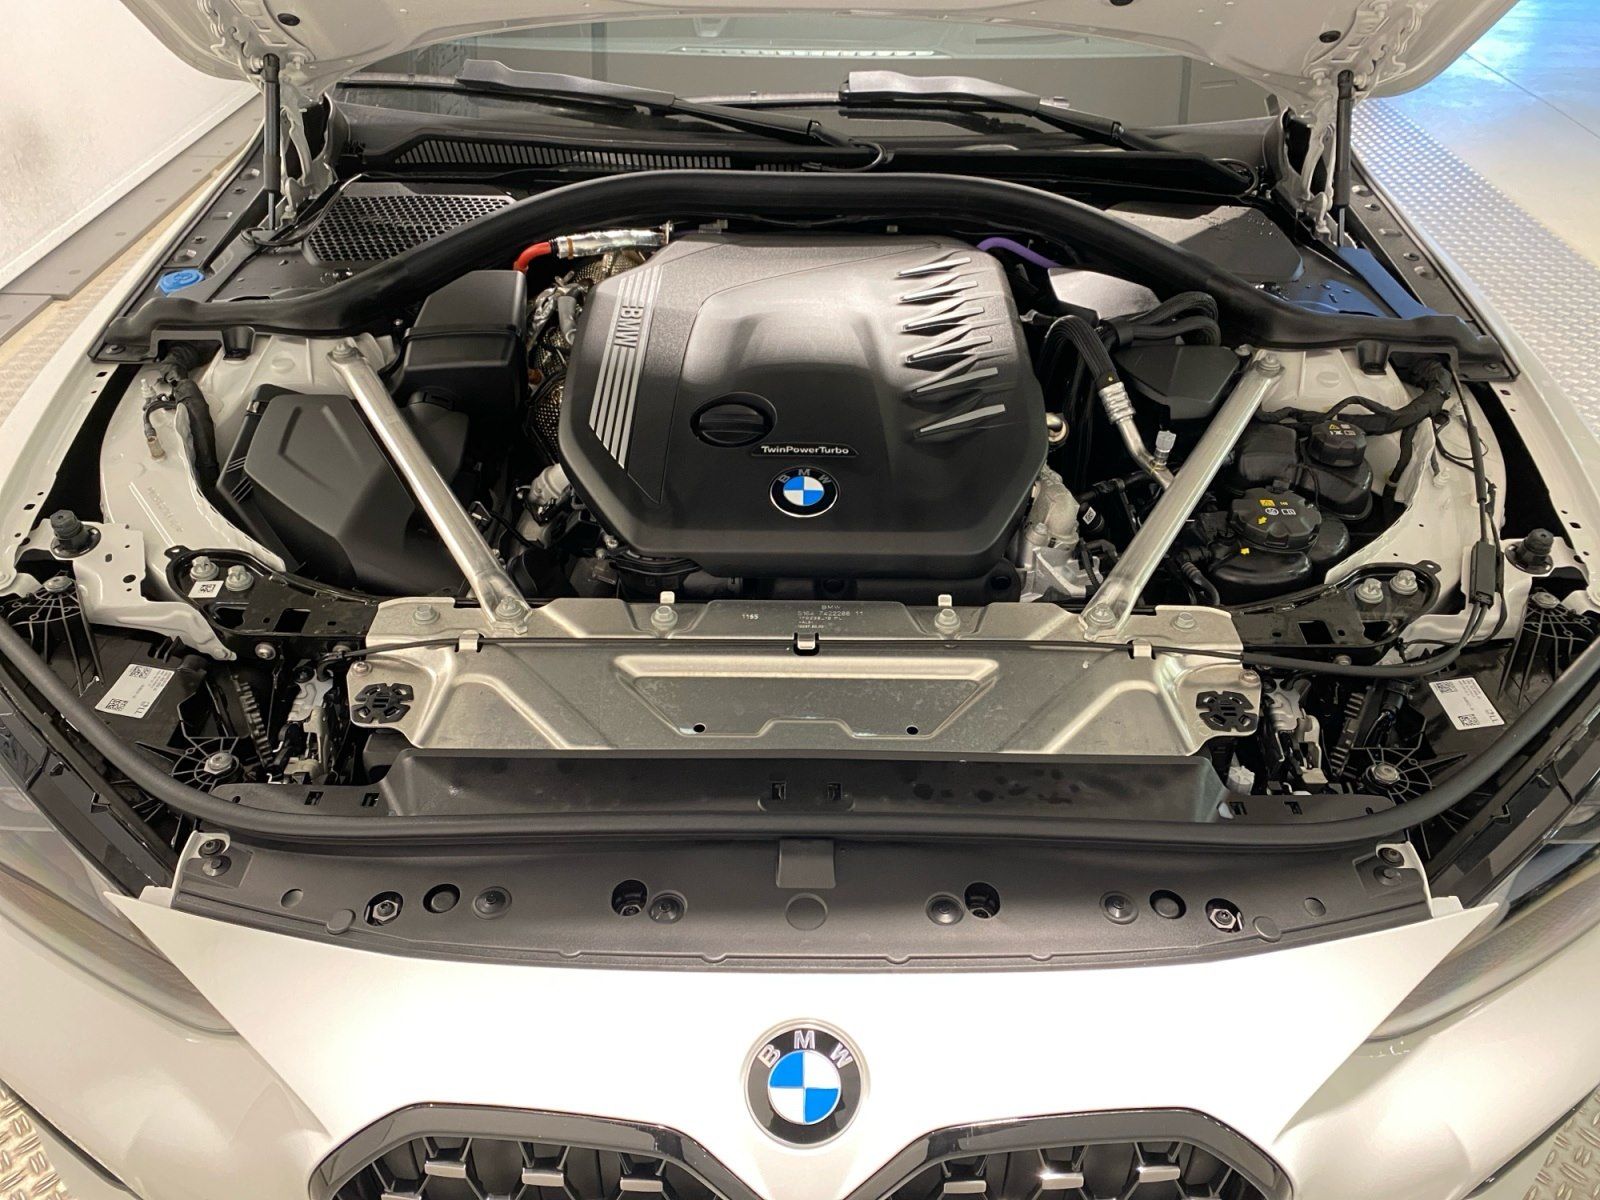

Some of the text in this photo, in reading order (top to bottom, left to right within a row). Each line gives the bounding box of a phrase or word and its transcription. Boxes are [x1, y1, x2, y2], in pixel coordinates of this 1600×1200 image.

[614, 305, 644, 348] BMW
[761, 445, 849, 454] TwinPowerTurbo
[777, 468, 832, 484] BMW
[757, 1030, 853, 1069] BMW
